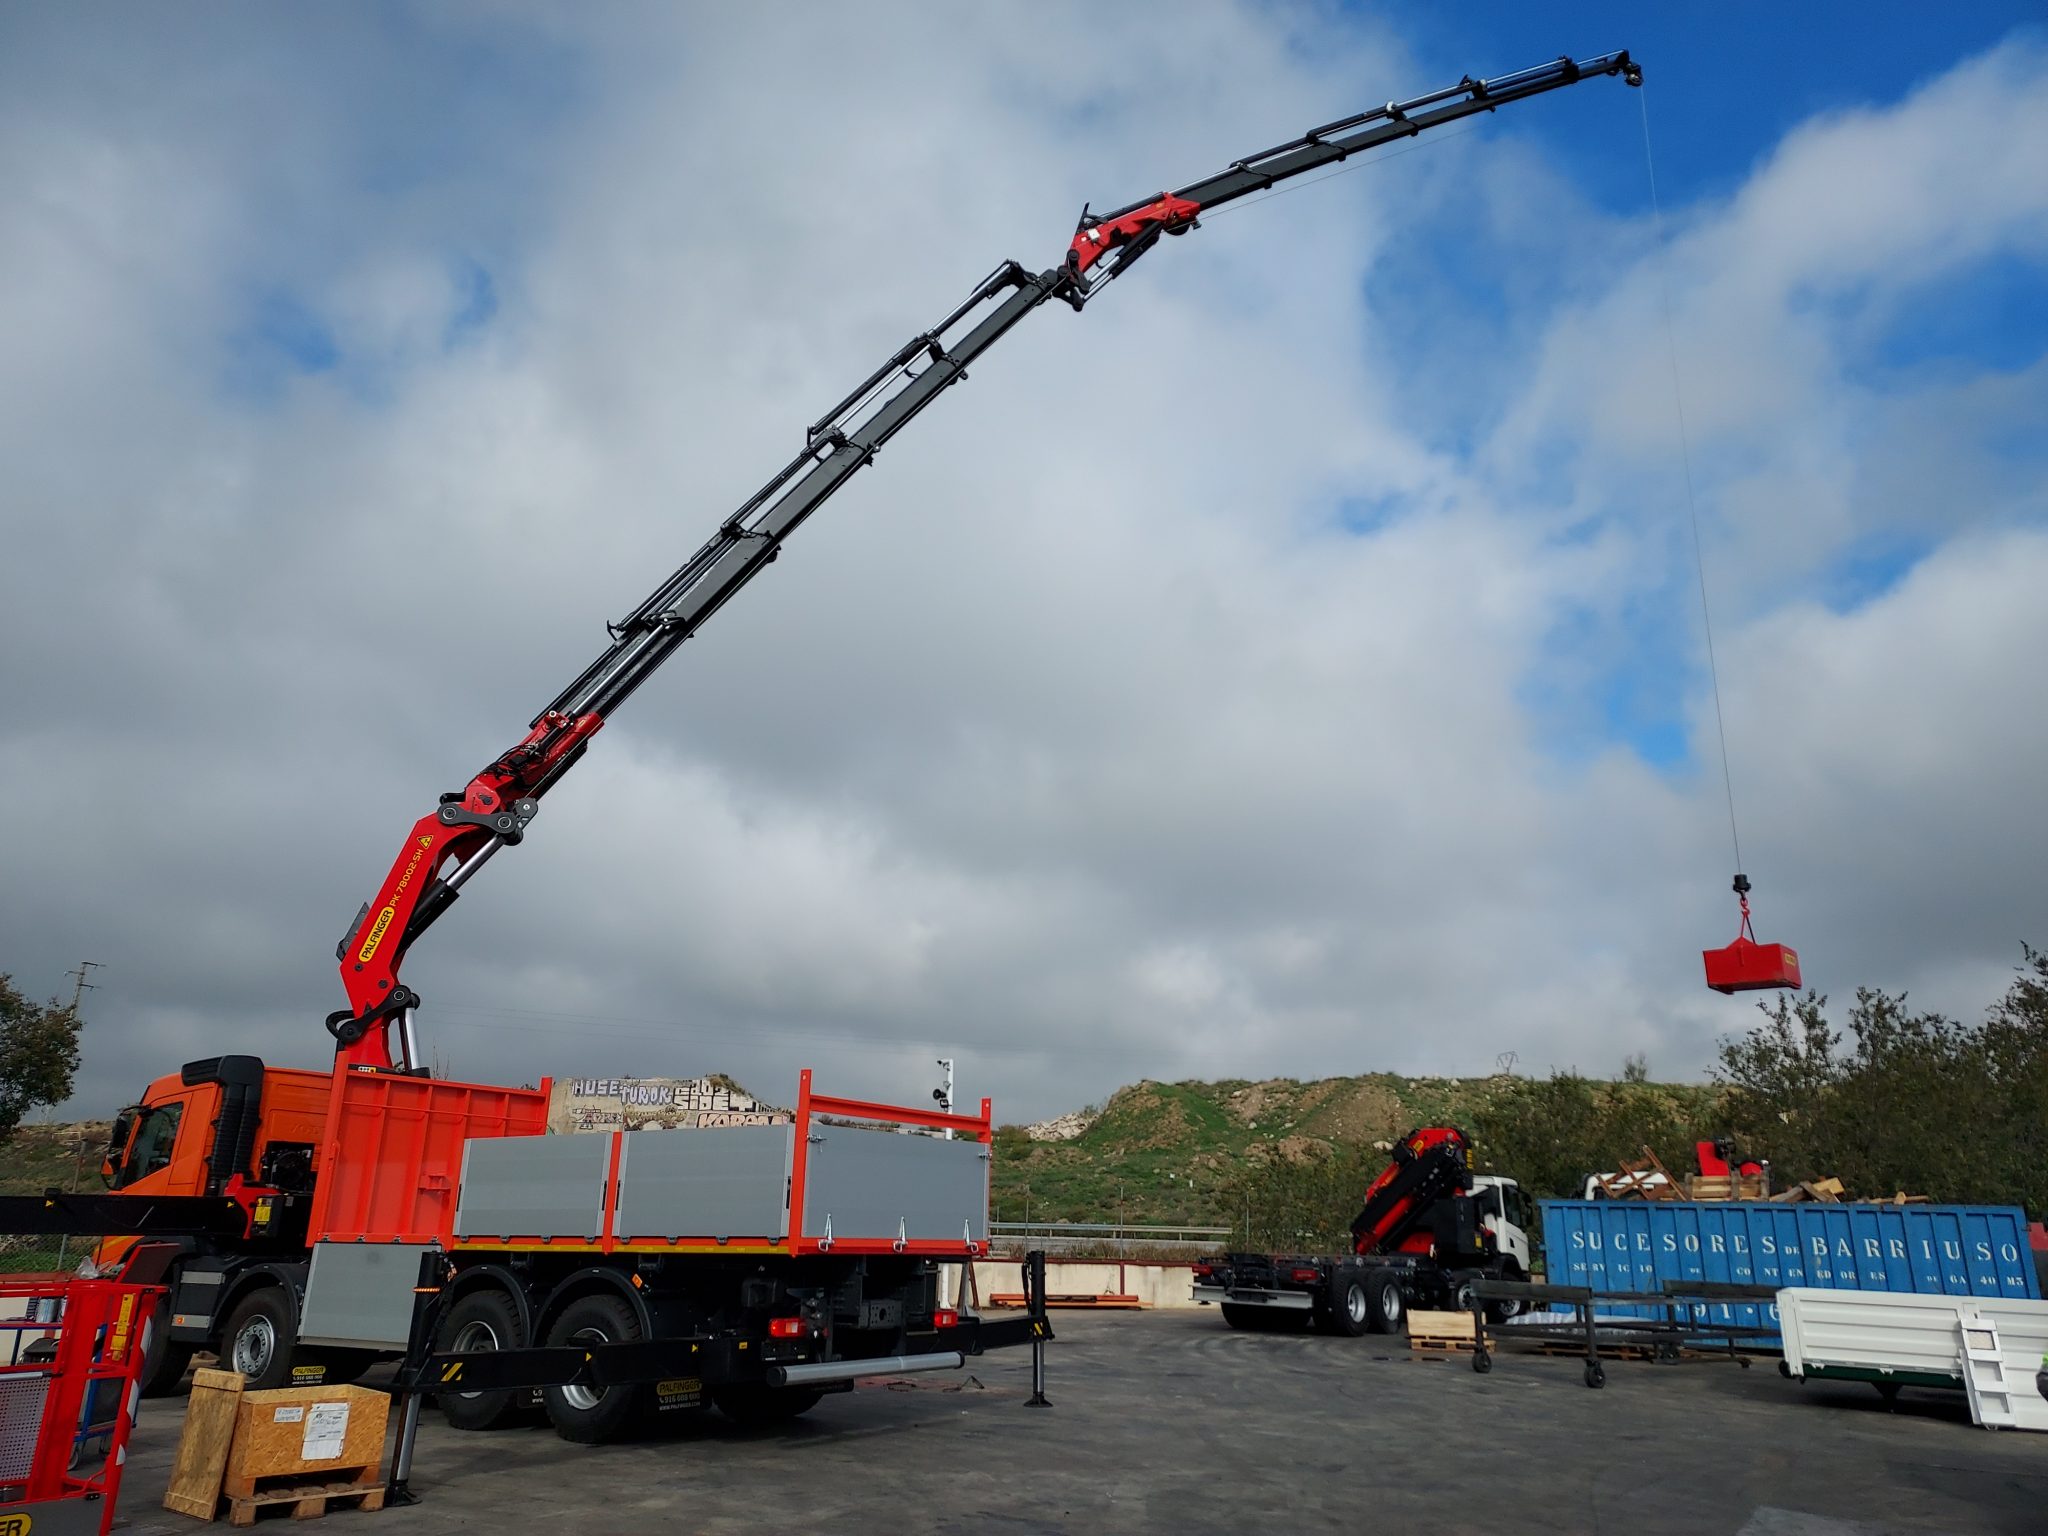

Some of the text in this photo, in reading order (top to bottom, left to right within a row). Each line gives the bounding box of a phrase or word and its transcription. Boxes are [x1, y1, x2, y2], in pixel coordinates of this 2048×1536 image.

[361, 910, 392, 959] PALFINGER
[389, 894, 401, 907] PK
[1572, 1231, 2018, 1262] SUCESORES DE BARRIUSO
